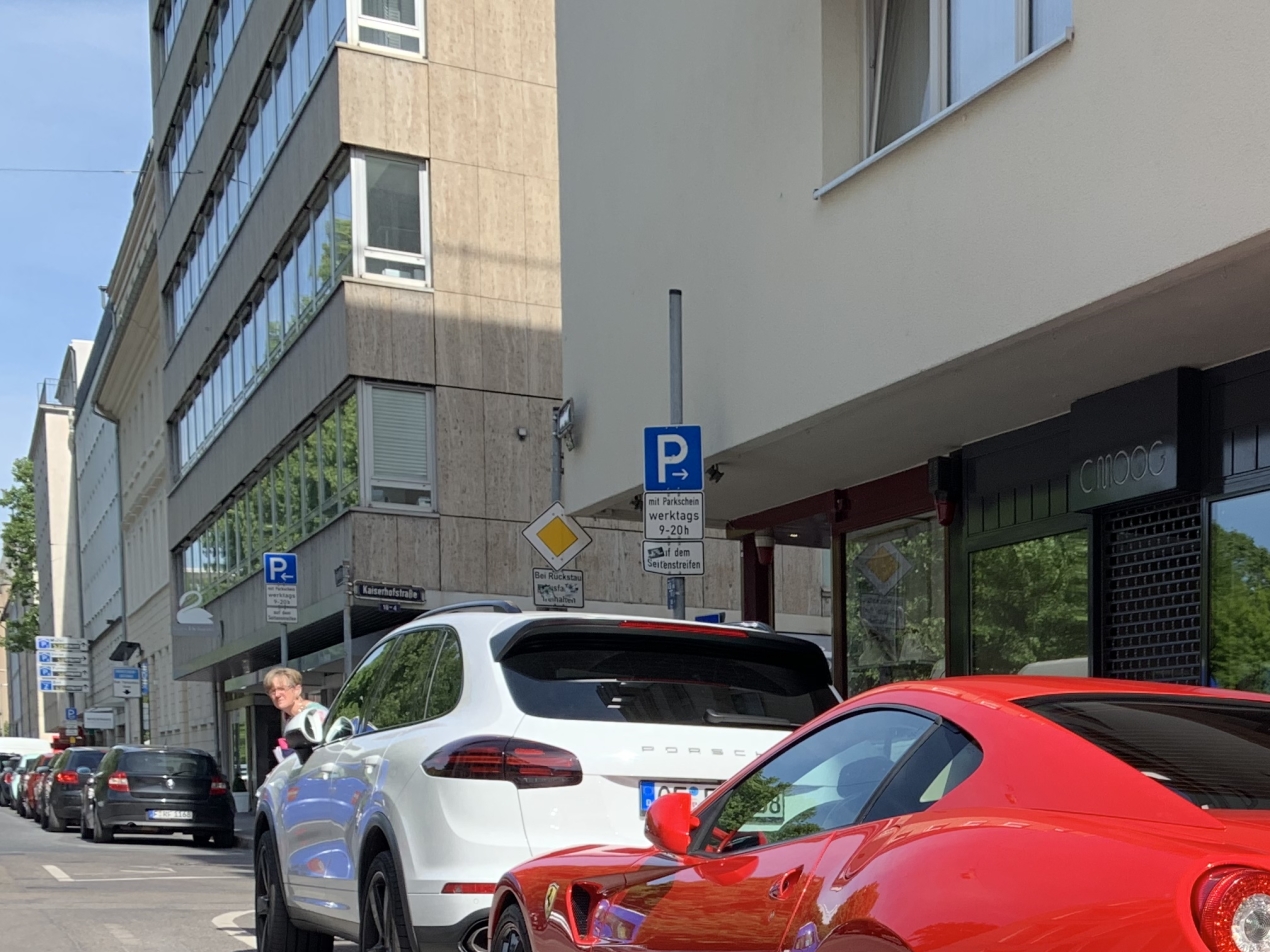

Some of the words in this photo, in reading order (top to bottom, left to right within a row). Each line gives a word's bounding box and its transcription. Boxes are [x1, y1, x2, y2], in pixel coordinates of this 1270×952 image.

[657, 434, 688, 483] P
[662, 497, 700, 506] Parkschein
[649, 510, 700, 523] werktags
[674, 548, 690, 557] dem
[269, 557, 288, 580] P
[648, 559, 700, 570] Seitenstreifen
[548, 572, 582, 582] Rückstau
[362, 585, 418, 599] Kaiserhofstraße
